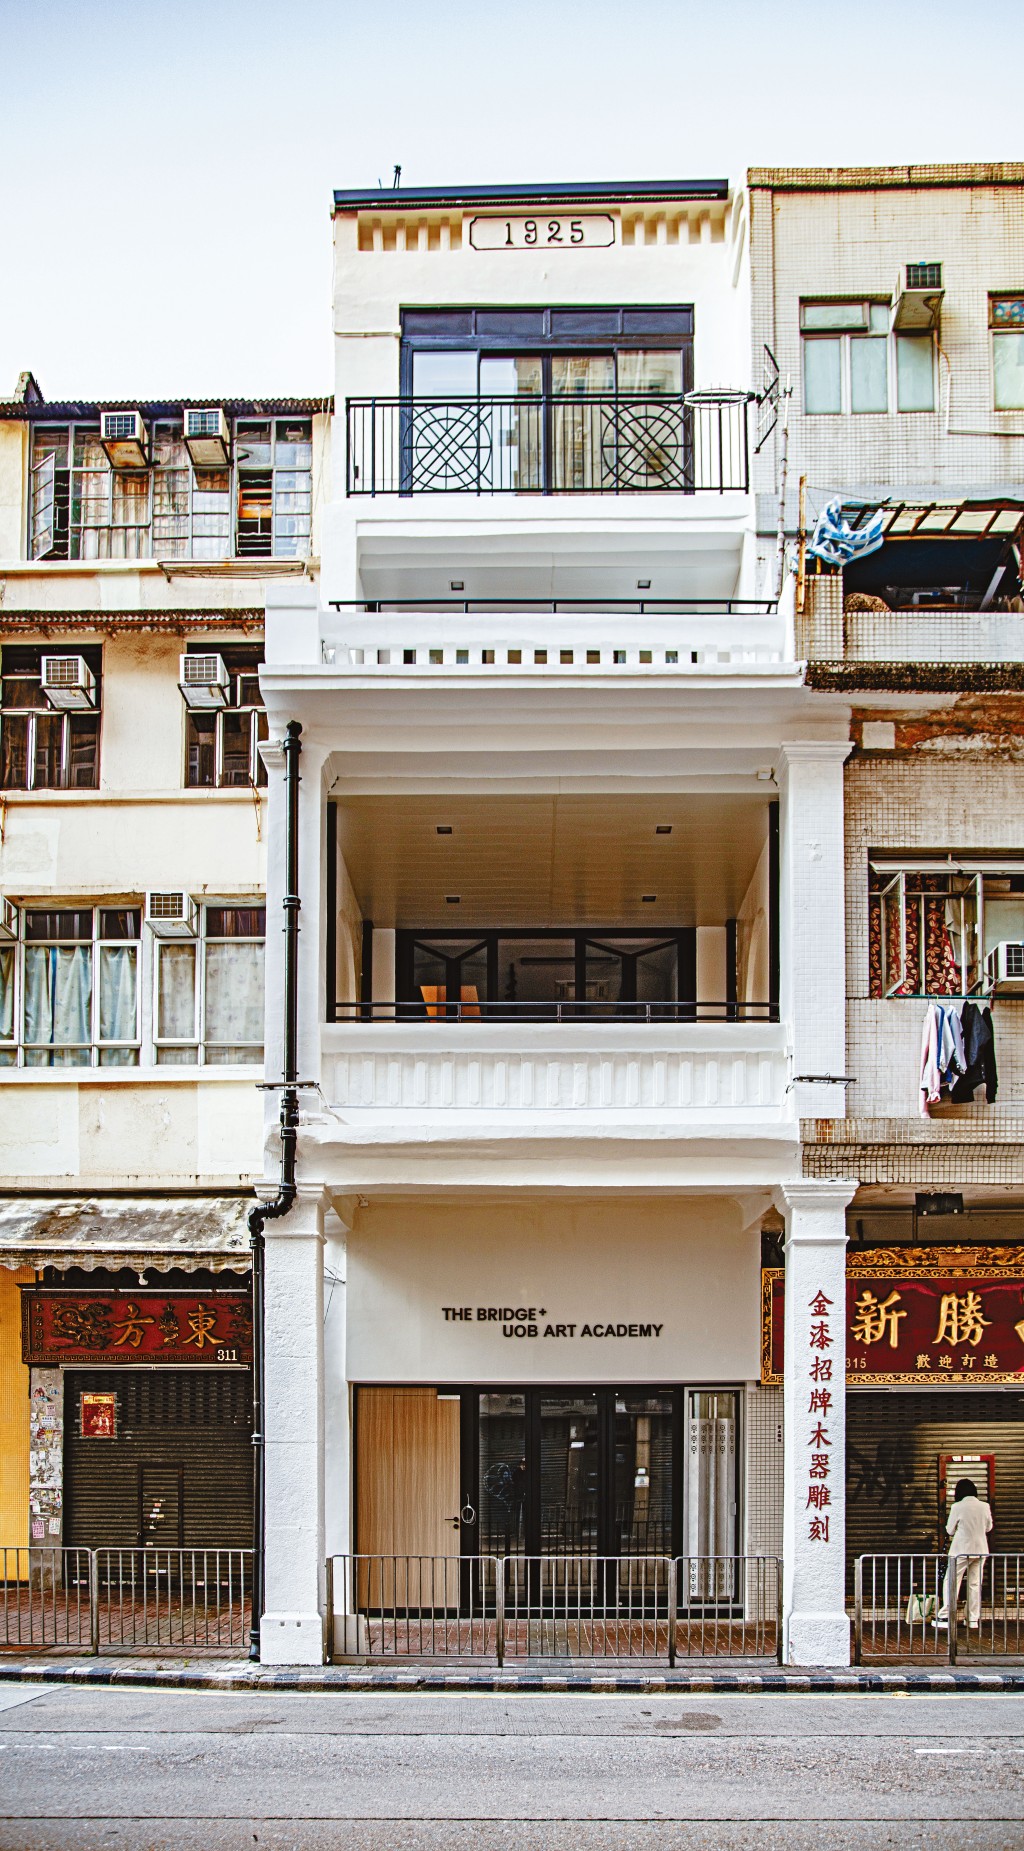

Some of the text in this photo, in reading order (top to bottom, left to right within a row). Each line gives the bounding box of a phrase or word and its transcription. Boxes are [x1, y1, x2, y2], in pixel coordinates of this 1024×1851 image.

[505, 220, 584, 245] 1925
[441, 1307, 472, 1321] THE
[850, 1290, 1024, 1348] 新勝
[502, 1324, 664, 1338] UOB ART ACADEMY
[217, 1349, 238, 1361] 311
[915, 1353, 999, 1369] 歡迎訂造
[806, 1289, 834, 1543] 金漆招牌木器雕刻
